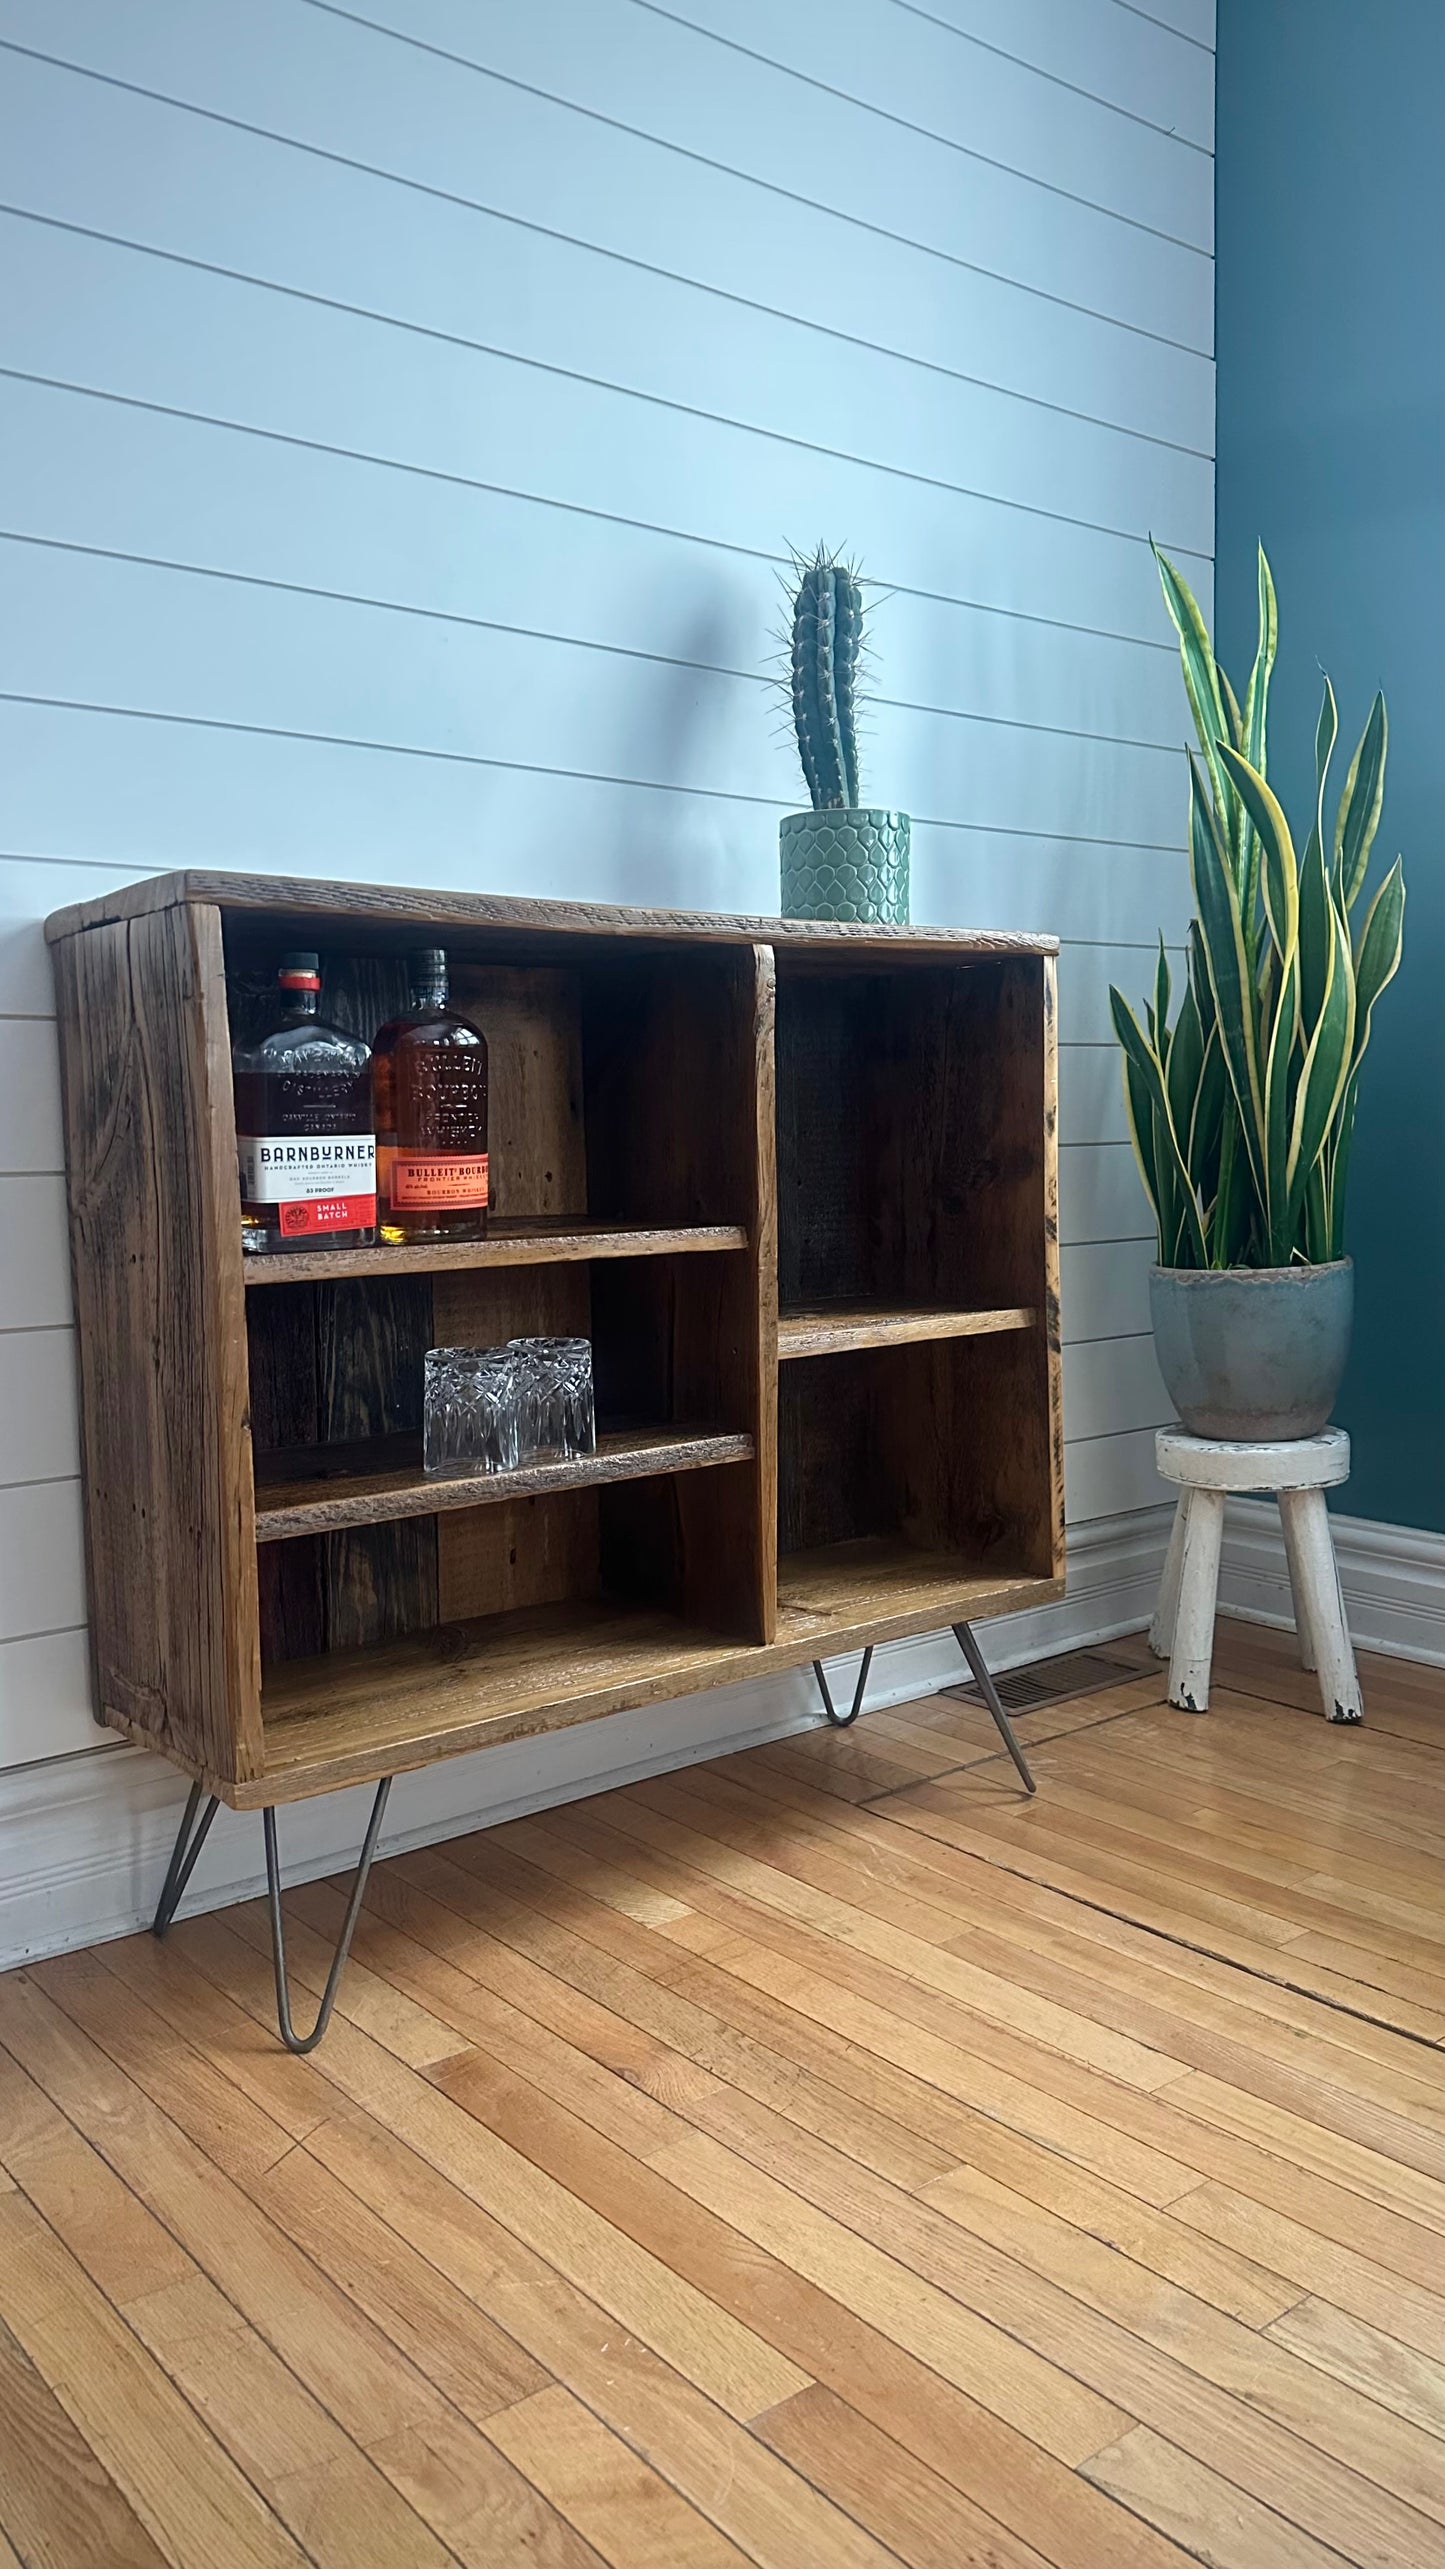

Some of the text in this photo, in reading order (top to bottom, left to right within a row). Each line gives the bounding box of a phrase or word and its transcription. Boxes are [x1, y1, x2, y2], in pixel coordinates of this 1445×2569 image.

[261, 1145, 375, 1162] BARNBURNER
[408, 1168, 454, 1177] BULLEIT
[317, 1203, 347, 1212] SMALL
[318, 1211, 348, 1220] BATCH
